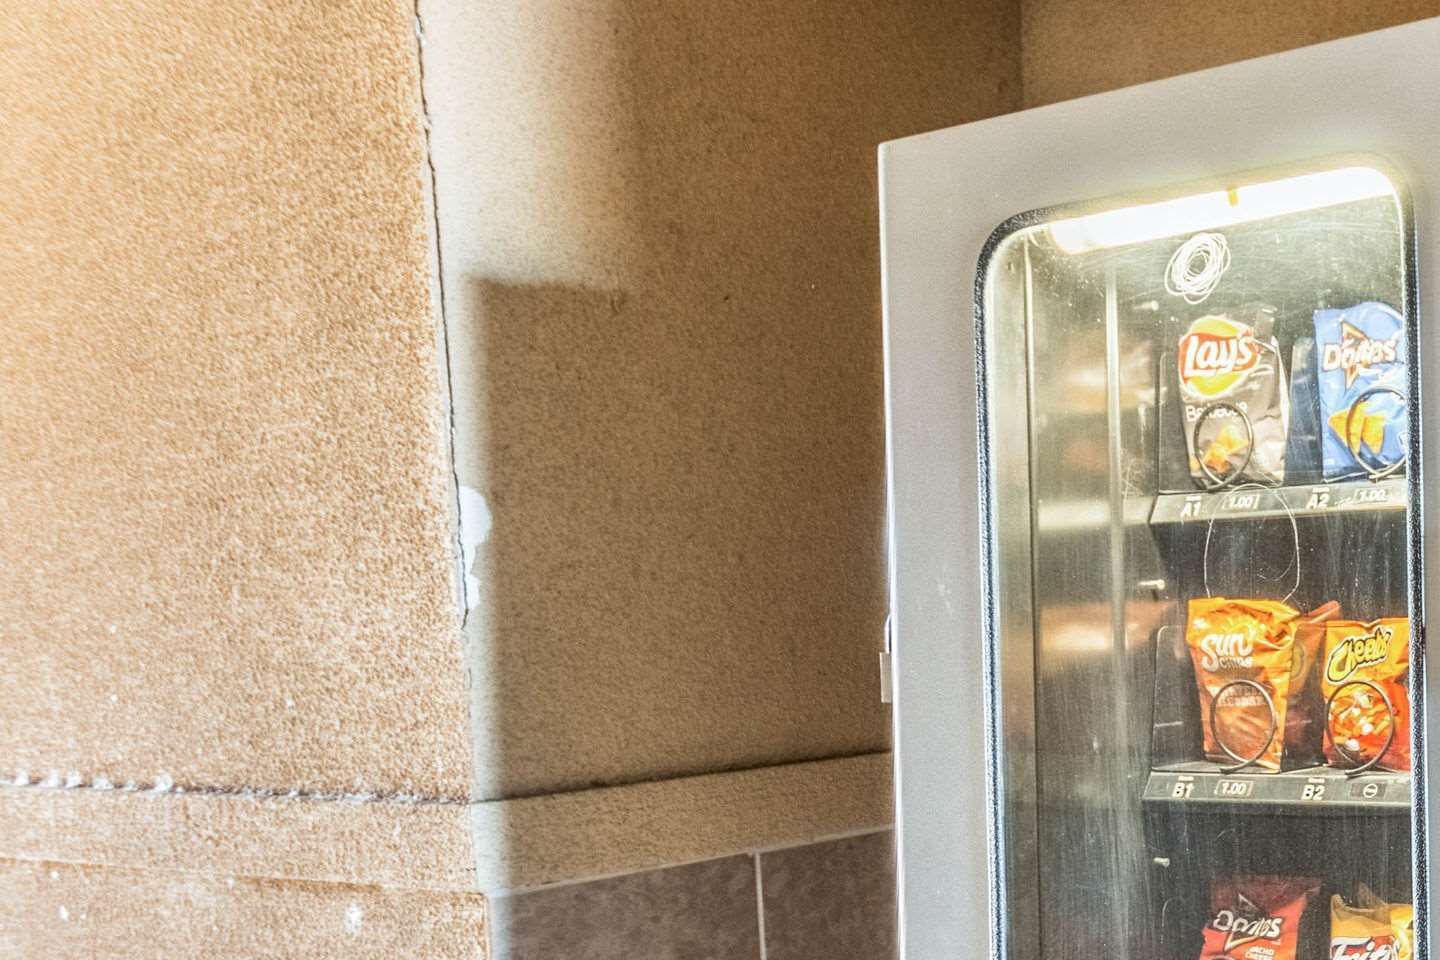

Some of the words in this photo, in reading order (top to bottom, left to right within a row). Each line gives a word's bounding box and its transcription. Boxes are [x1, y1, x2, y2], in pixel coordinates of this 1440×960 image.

[1306, 493, 1329, 509] A2
[1181, 501, 1201, 518] A1
[1172, 783, 1194, 798] B1
[1220, 782, 1247, 795] 1.00
[1302, 785, 1325, 799] B2
[1212, 909, 1283, 939] Doritos
